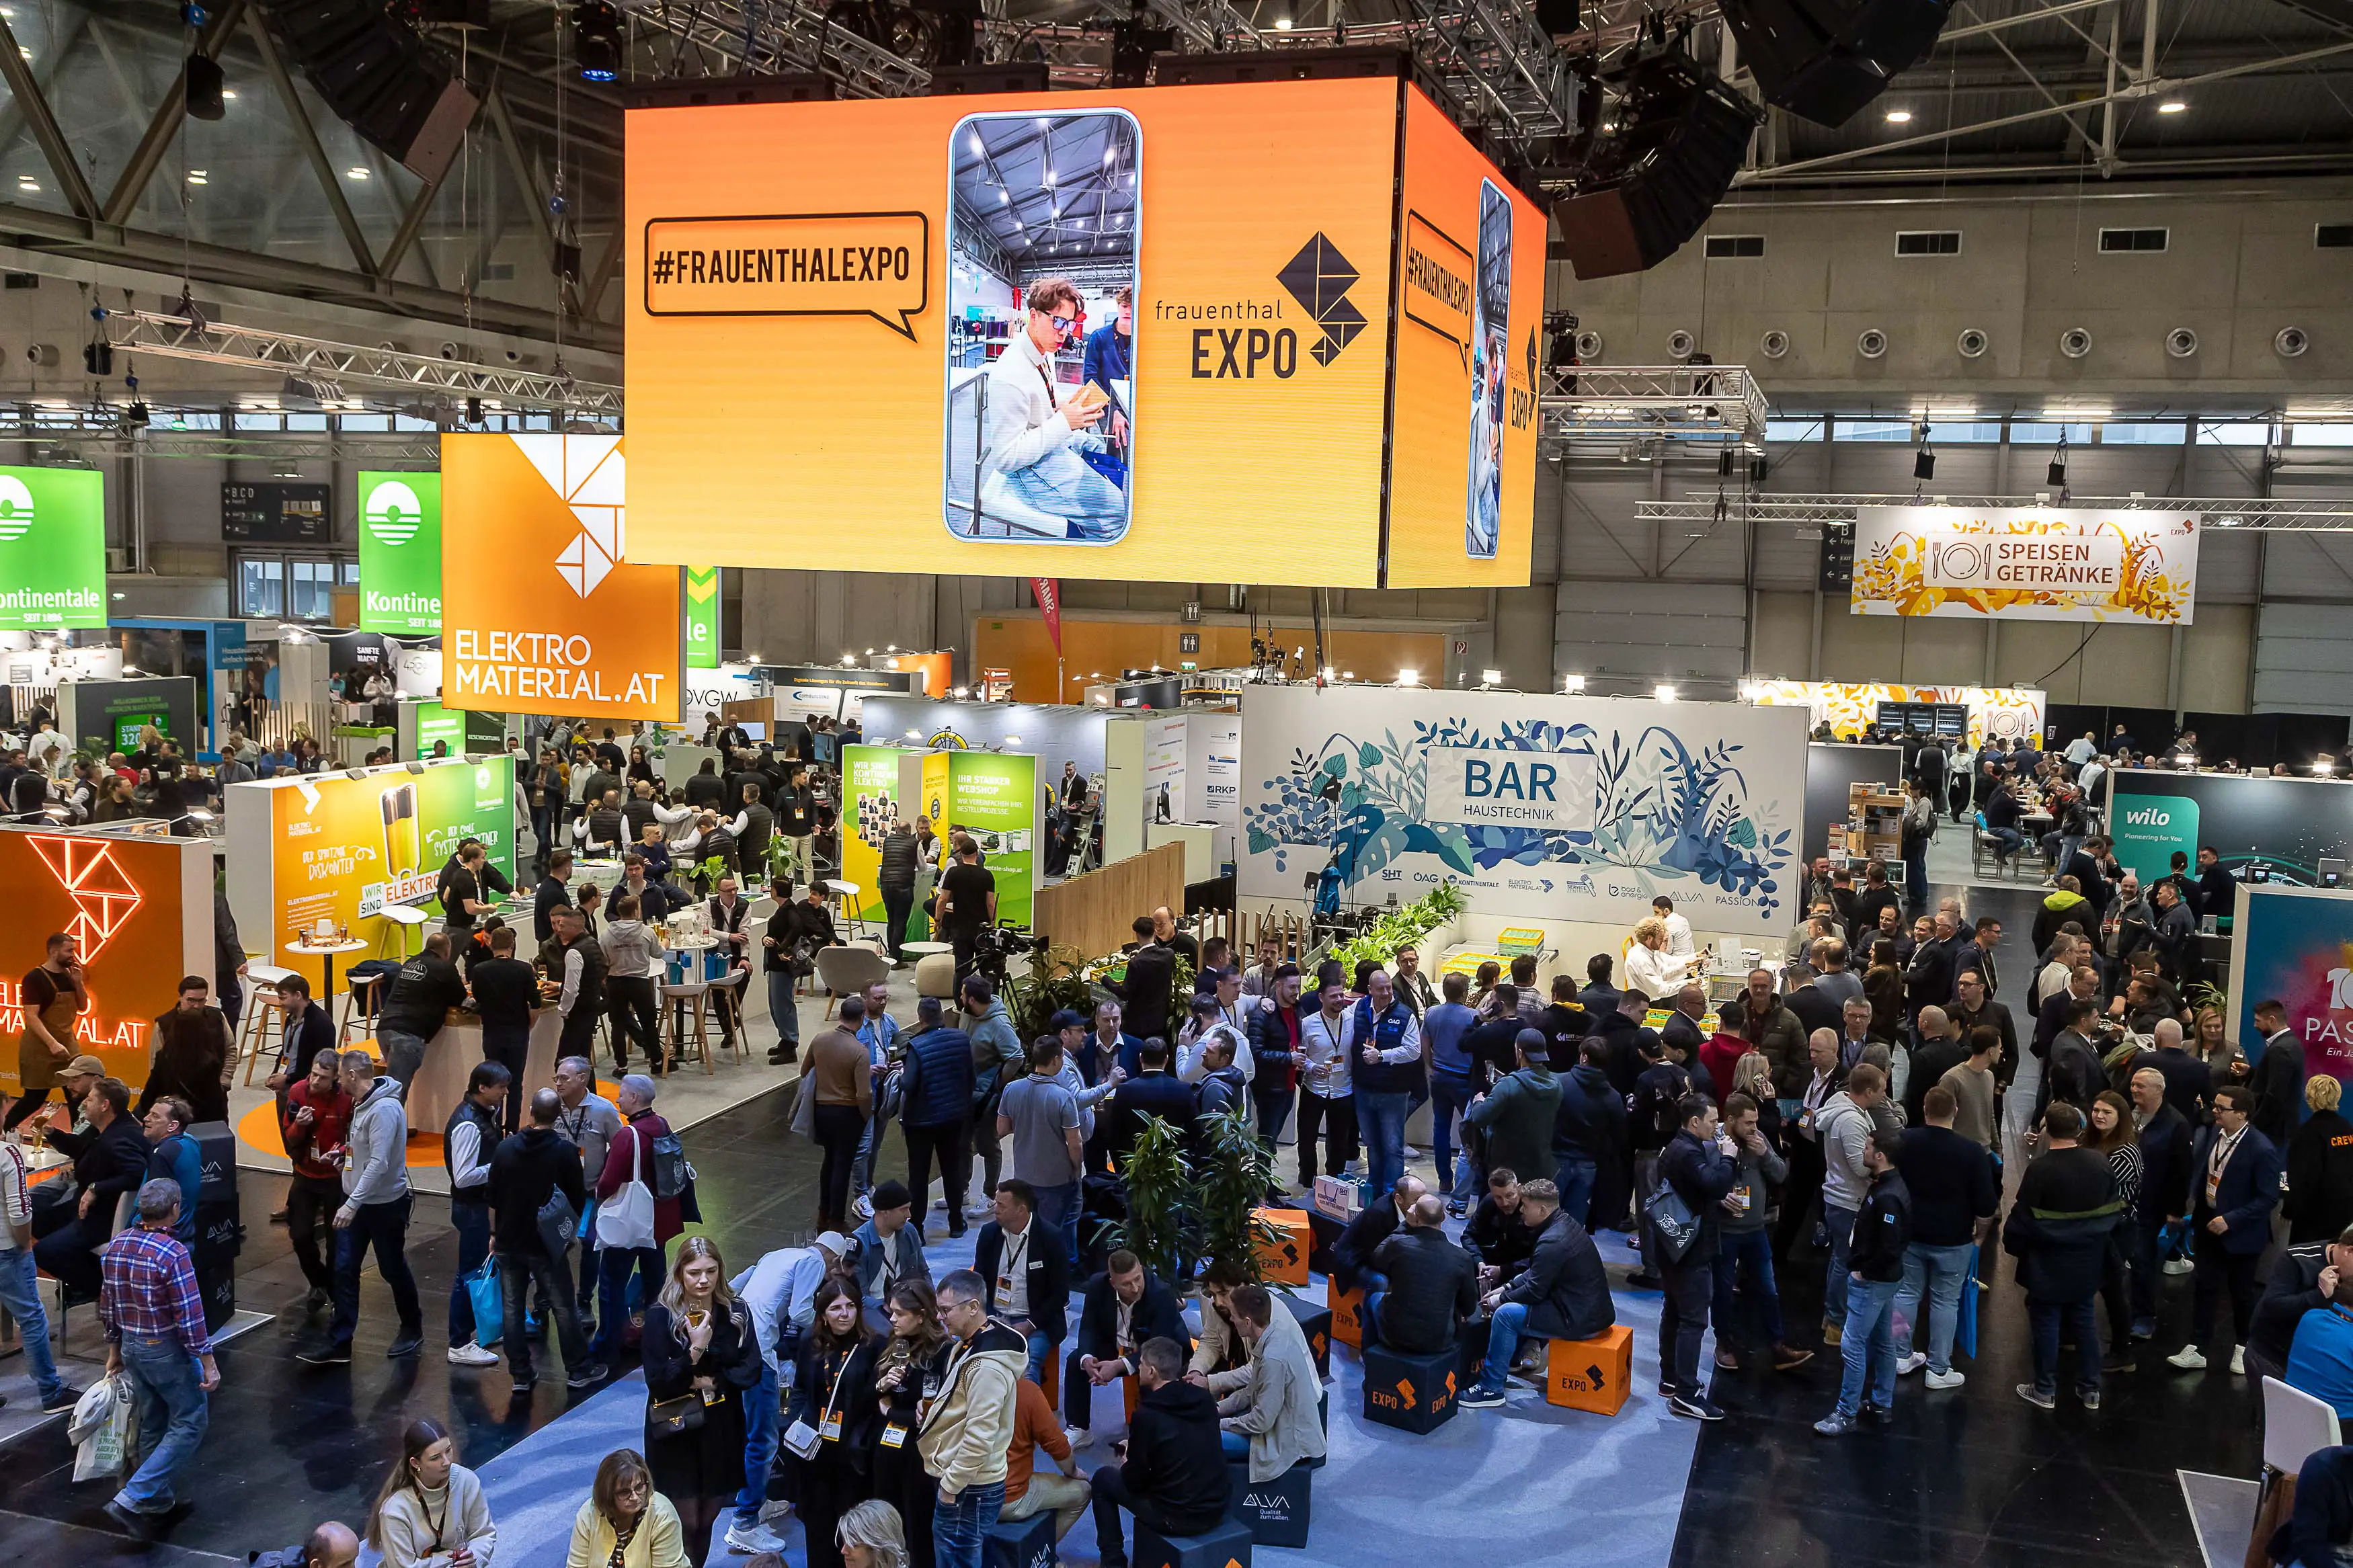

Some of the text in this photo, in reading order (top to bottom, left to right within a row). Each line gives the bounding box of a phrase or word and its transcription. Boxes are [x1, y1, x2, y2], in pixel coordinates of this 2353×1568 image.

[653, 246, 910, 284] #FRAUENTHALEXPO
[1408, 246, 1469, 317] #FRAUENTHALEXPO
[1156, 300, 1282, 319] frauenthal
[1191, 328, 1297, 378] EXPO
[1511, 387, 1527, 431] EXPO
[1998, 543, 2089, 561] SPEISEN
[1997, 563, 2113, 583] GETRÄNKE
[0, 587, 99, 608] ontinentale
[366, 591, 441, 614] Kontine
[455, 629, 591, 665] ELEKTRO
[455, 663, 664, 704] MATERIAL.AT
[853, 761, 869, 770] WIR
[957, 774, 972, 784] IHR
[1464, 759, 1557, 801] BAR
[957, 785, 999, 795] WEBSHOP
[1215, 786, 1236, 794] RKP
[1464, 804, 1554, 821] HAUSTECHNIK
[2126, 808, 2170, 826] wilo
[2124, 833, 2159, 841] Pioneering
[984, 865, 1023, 874] entale-shop.at
[1382, 869, 1402, 878] SHT
[1414, 872, 1439, 883] ÖAG
[364, 885, 382, 898] WIR
[1458, 879, 1500, 888] KONTINENTALE
[361, 899, 382, 914] SIND
[2326, 1046, 2342, 1057] Ein
[1336, 1312, 1353, 1328] EXPO
[1562, 1377, 1587, 1392] EXPO
[1372, 1391, 1397, 1409] EXPO
[1432, 1395, 1446, 1414] EXPO
